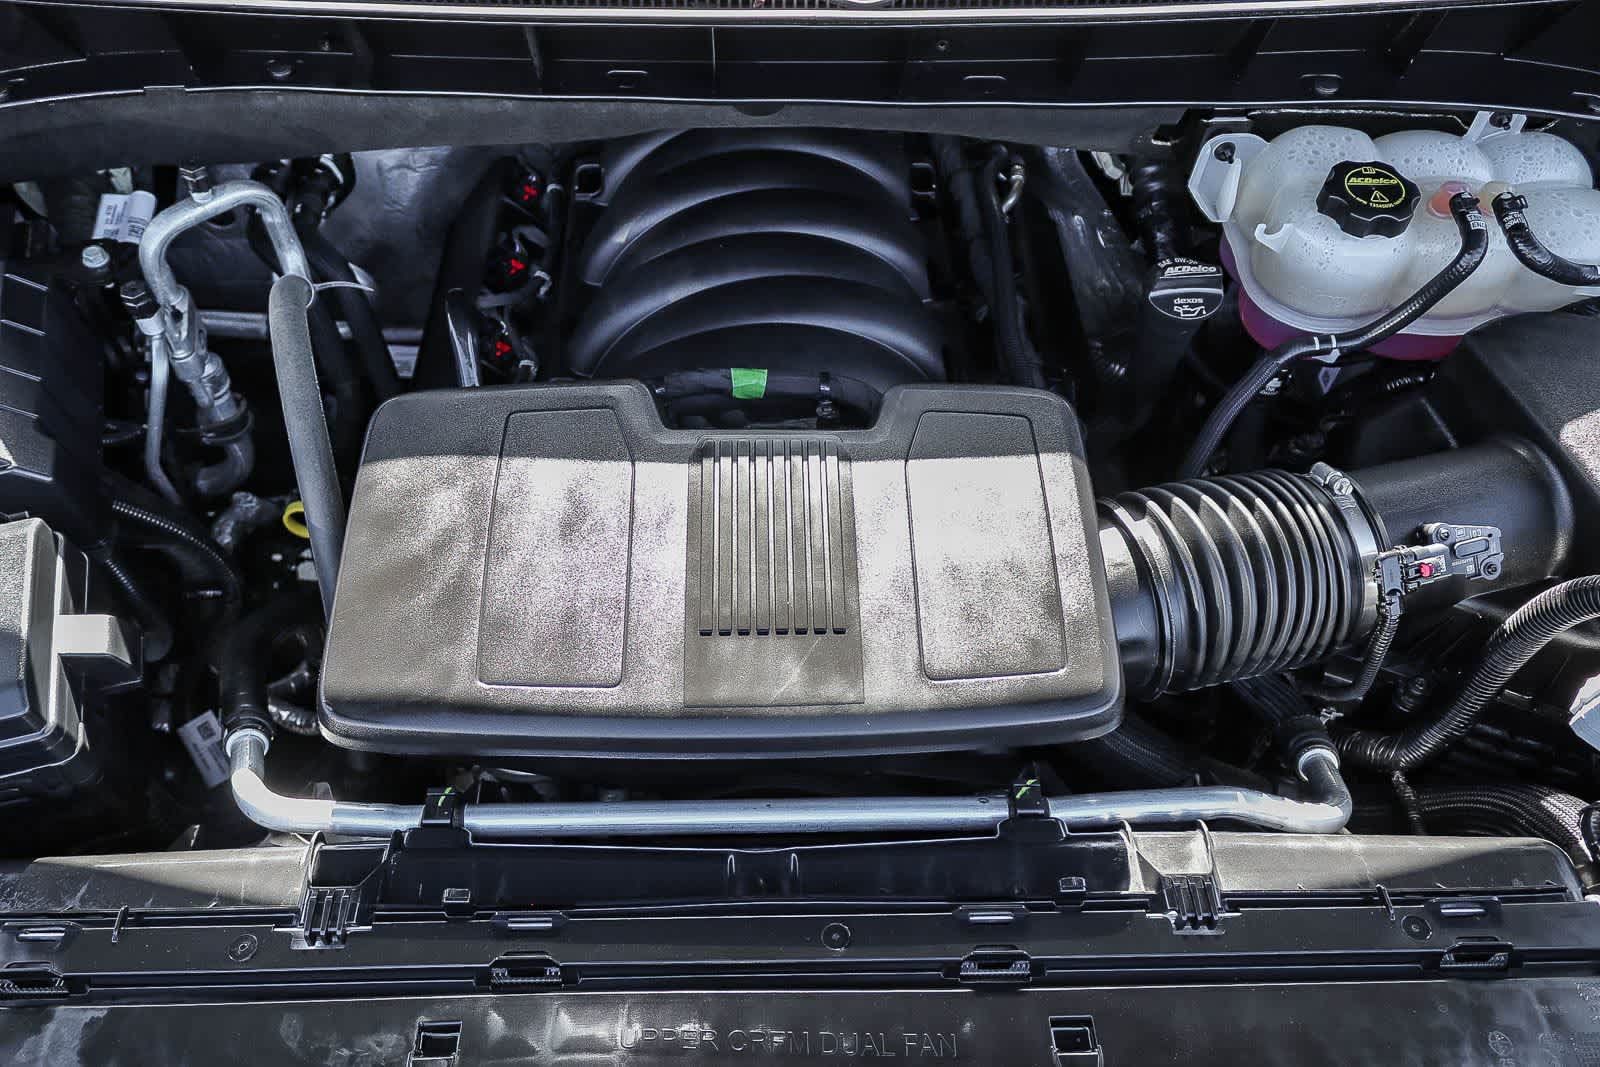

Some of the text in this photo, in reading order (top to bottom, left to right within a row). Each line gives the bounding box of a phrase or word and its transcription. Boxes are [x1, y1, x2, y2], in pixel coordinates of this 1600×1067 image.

[1348, 177, 1398, 186] ACDelco
[1164, 265, 1217, 276] ACDelco
[1173, 297, 1204, 305] dexos
[620, 1027, 720, 1051] UPPER
[818, 1031, 897, 1057] DUAL
[902, 1032, 957, 1057] FAN
